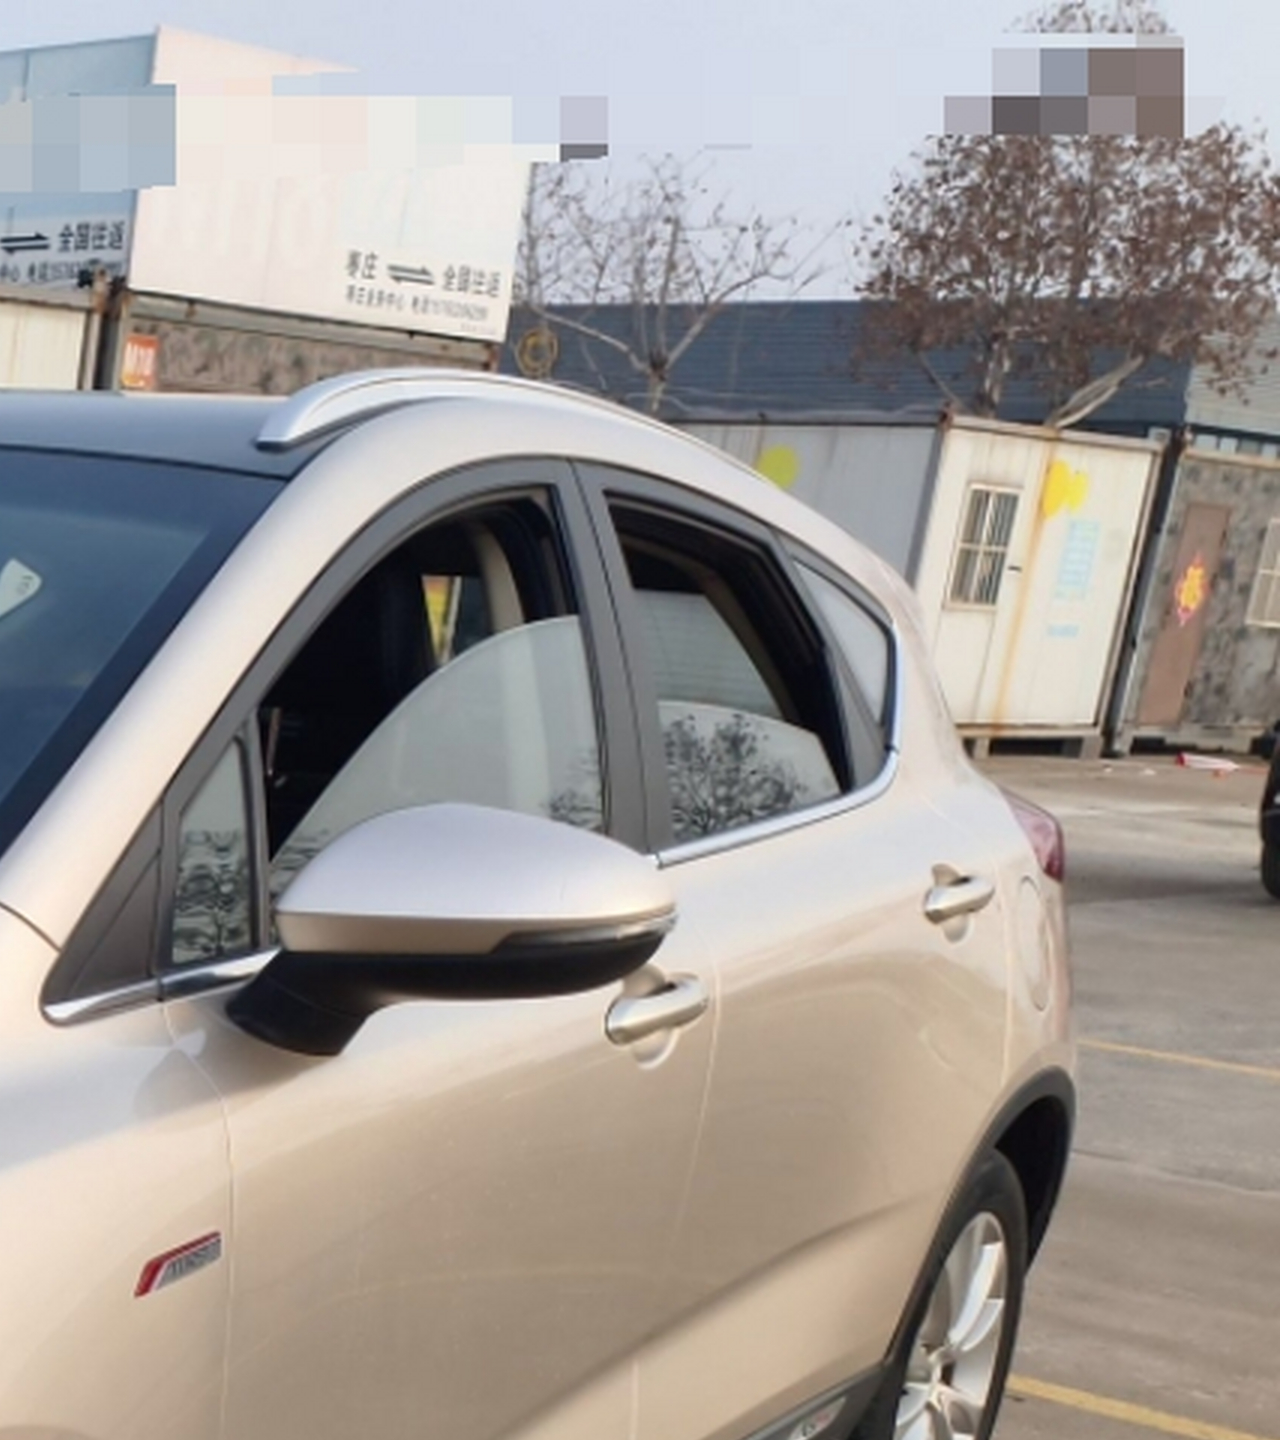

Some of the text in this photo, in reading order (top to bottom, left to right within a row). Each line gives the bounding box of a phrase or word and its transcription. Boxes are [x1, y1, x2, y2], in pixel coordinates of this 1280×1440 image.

[58, 220, 125, 253] 全国往返
[441, 263, 502, 299] 全国往返
